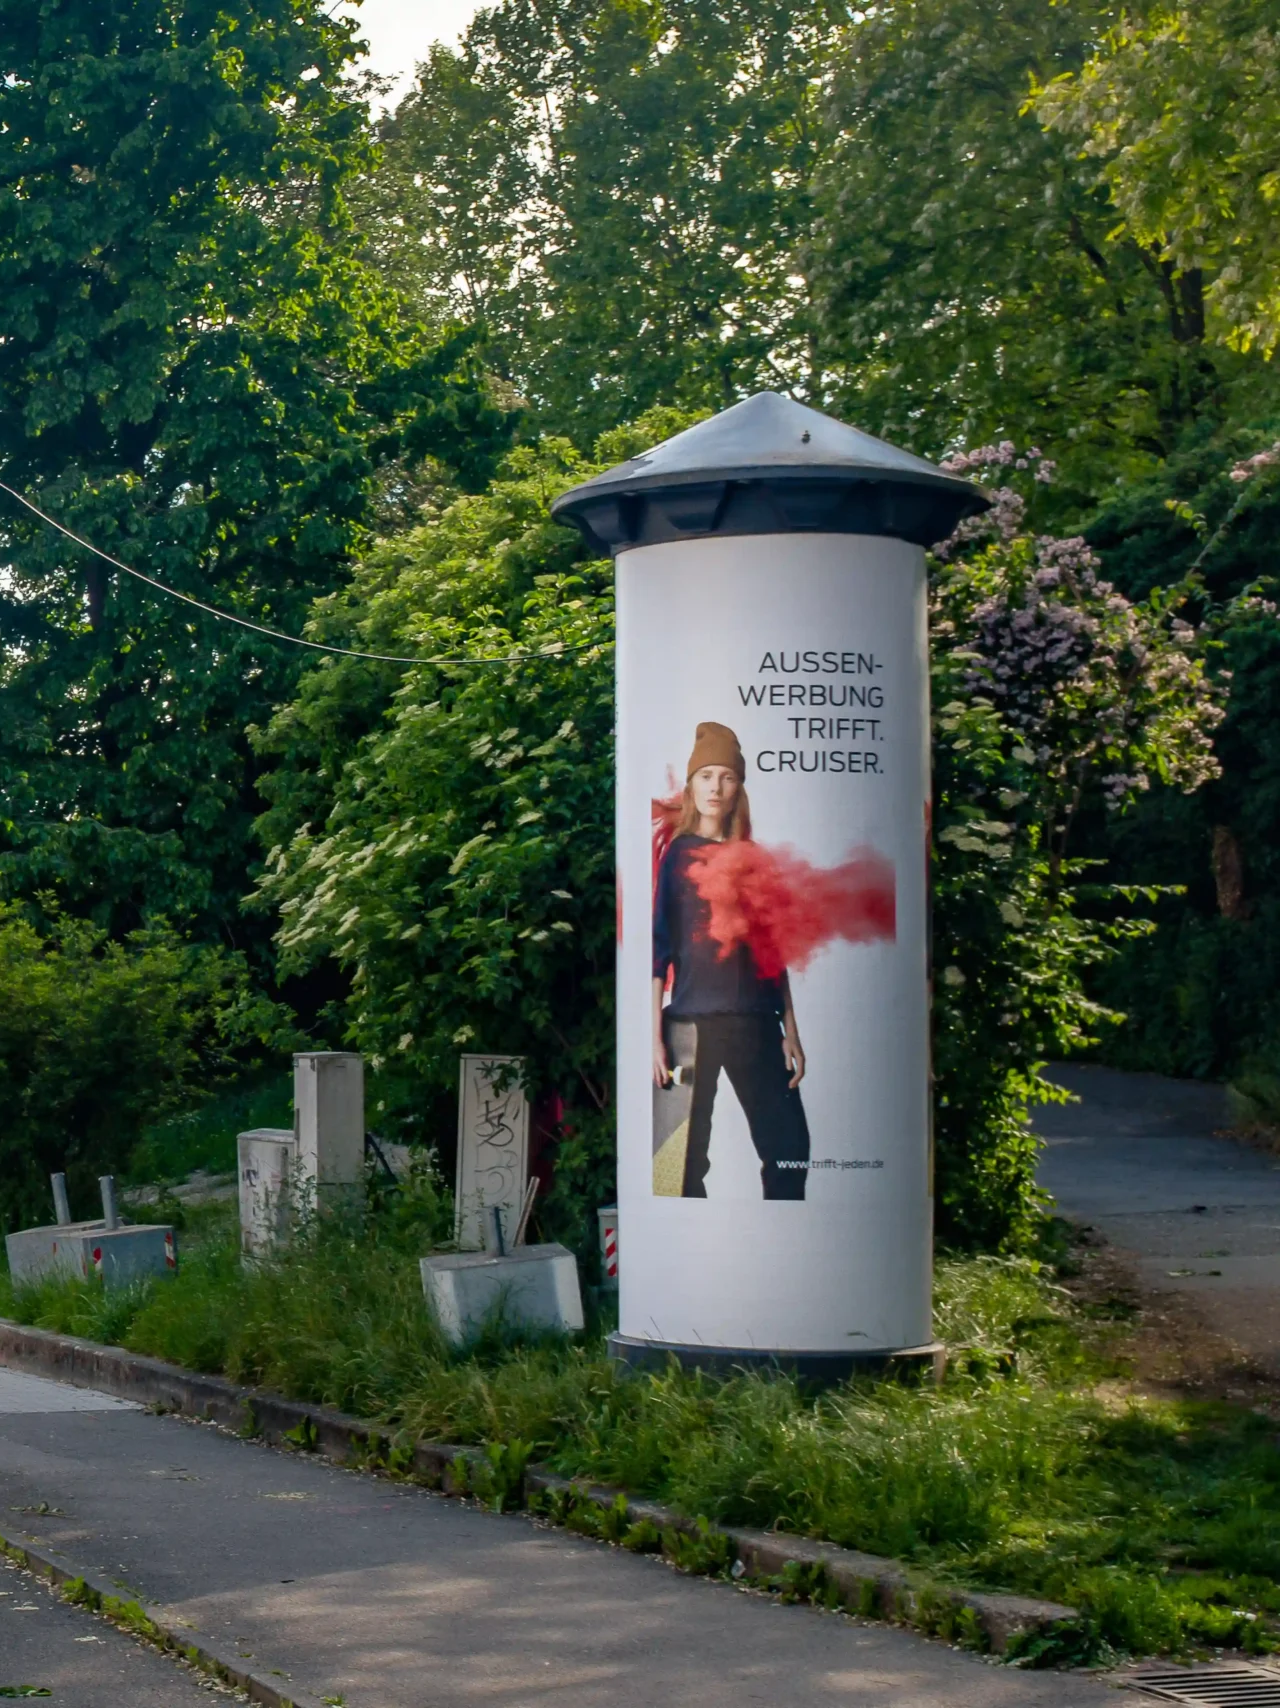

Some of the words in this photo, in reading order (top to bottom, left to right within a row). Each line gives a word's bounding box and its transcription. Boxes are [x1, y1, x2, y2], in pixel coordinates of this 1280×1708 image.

[758, 651, 884, 675] AUSSEN-
[737, 684, 884, 708] WERBUNG
[787, 717, 884, 741] TRIFFT.
[756, 750, 884, 774] CRUISER.
[776, 1158, 884, 1171] www.trifft-jeden.de
